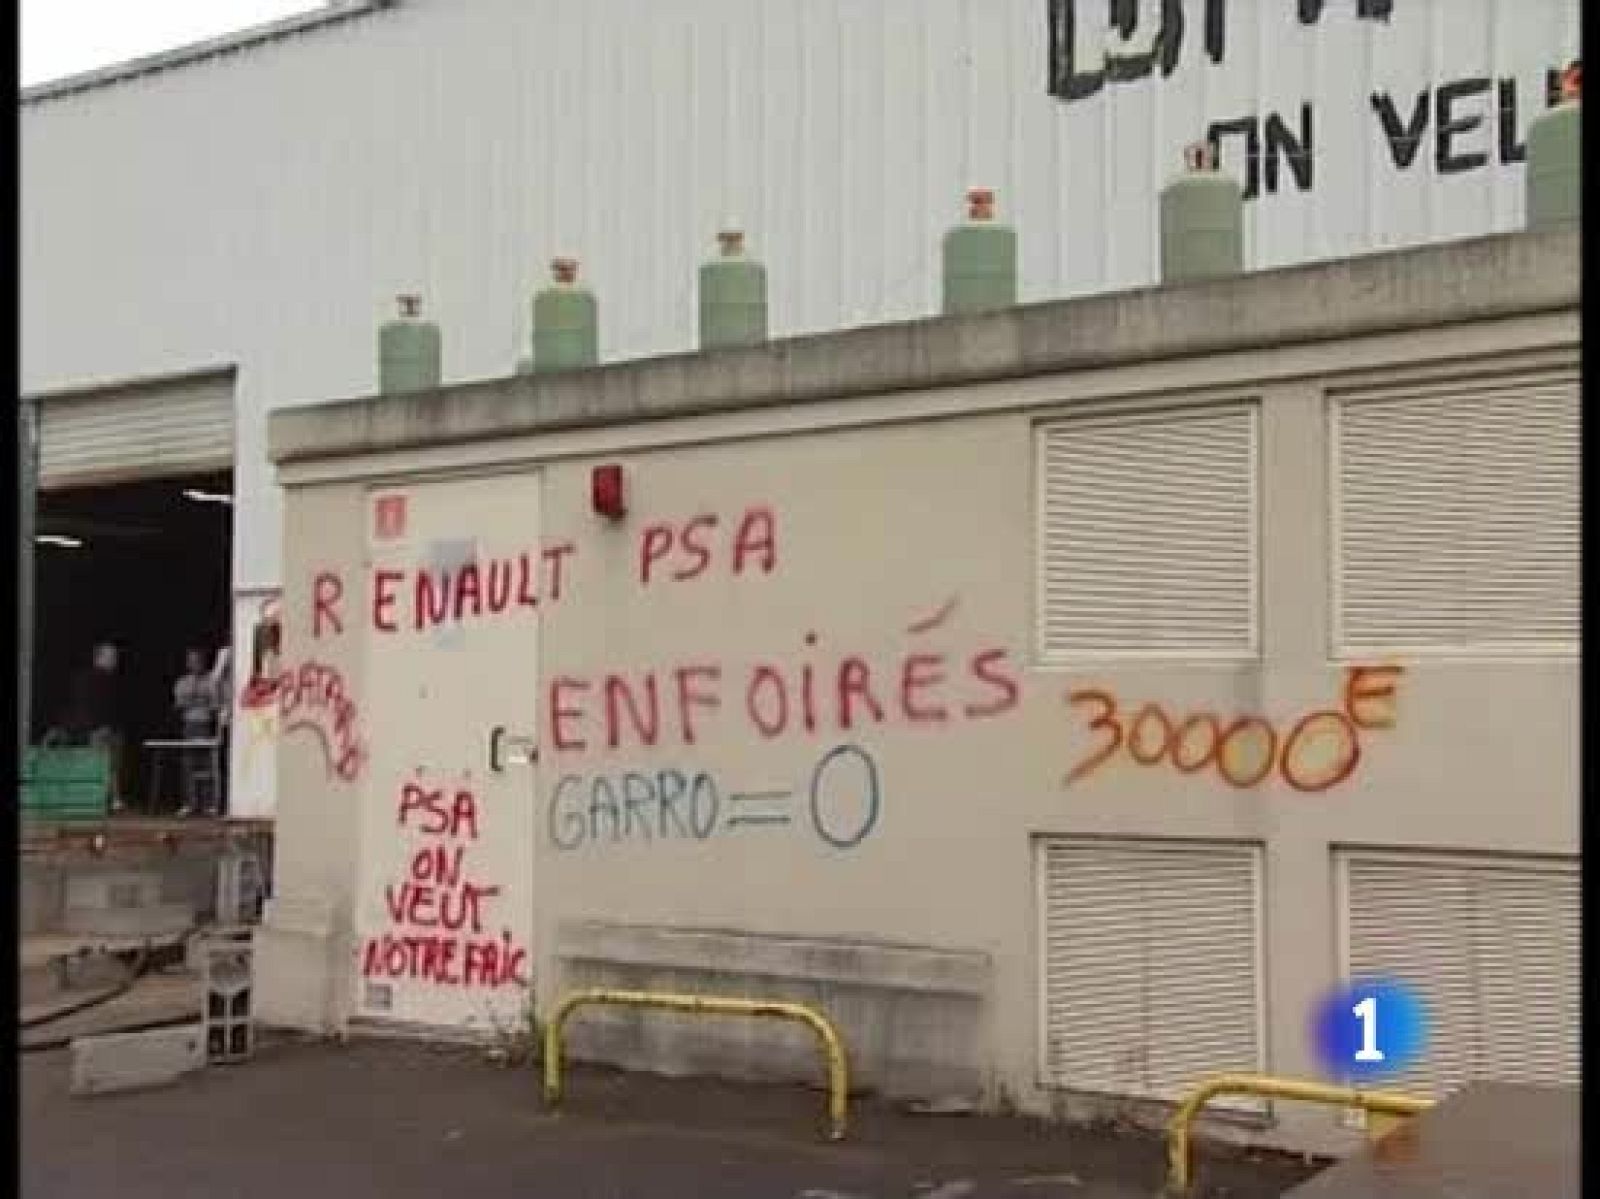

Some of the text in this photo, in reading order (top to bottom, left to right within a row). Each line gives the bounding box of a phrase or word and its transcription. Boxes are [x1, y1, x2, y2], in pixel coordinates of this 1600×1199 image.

[638, 507, 777, 583] PSA
[398, 782, 478, 839] PSA
[412, 846, 464, 886] ON
[385, 882, 499, 934] VEUT
